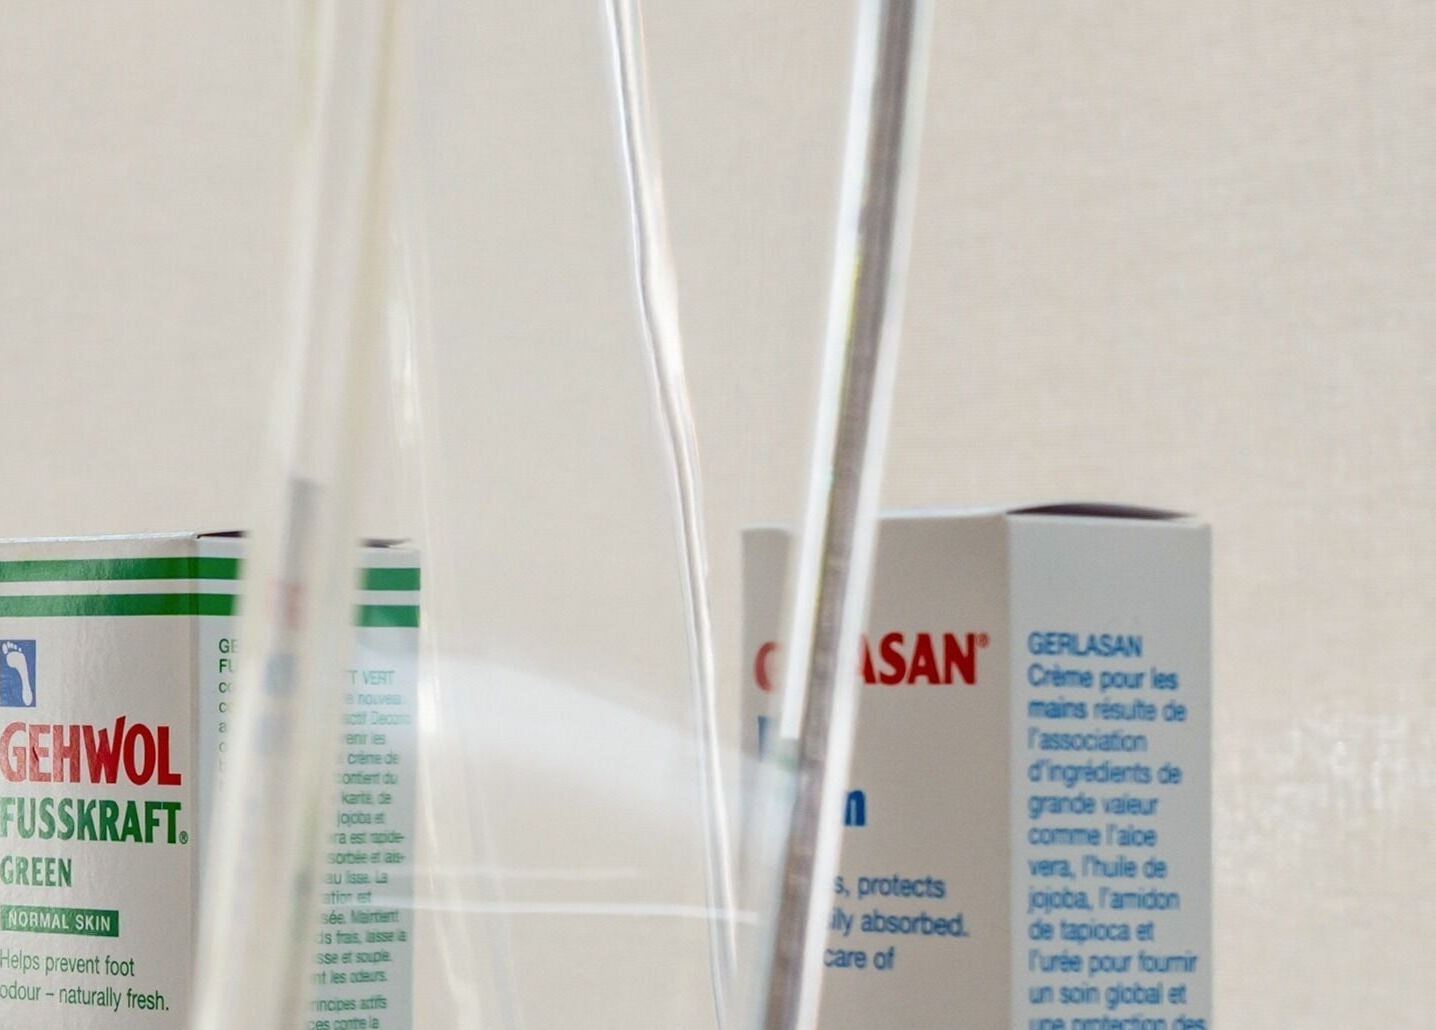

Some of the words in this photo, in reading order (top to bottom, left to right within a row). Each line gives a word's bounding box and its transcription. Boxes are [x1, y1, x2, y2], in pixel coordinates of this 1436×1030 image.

[1028, 631, 1143, 659] GERLASAN
[1100, 671, 1144, 694] pour
[1151, 668, 1179, 691] les
[1028, 698, 1088, 721] mains
[1162, 700, 1187, 723] de
[1158, 762, 1182, 785] de
[0, 855, 72, 887] GREEN
[857, 874, 946, 899] protects
[8, 910, 69, 929] NORMAL
[75, 914, 111, 931] SKIN
[860, 909, 970, 937] absorbed.
[0, 949, 40, 974] Helps
[45, 955, 100, 975] prevent
[105, 955, 135, 976] foot
[824, 948, 867, 968] care
[873, 946, 895, 970] of
[0, 980, 41, 1000] odour
[59, 985, 122, 1012] naturally
[126, 988, 169, 1011] fresh.
